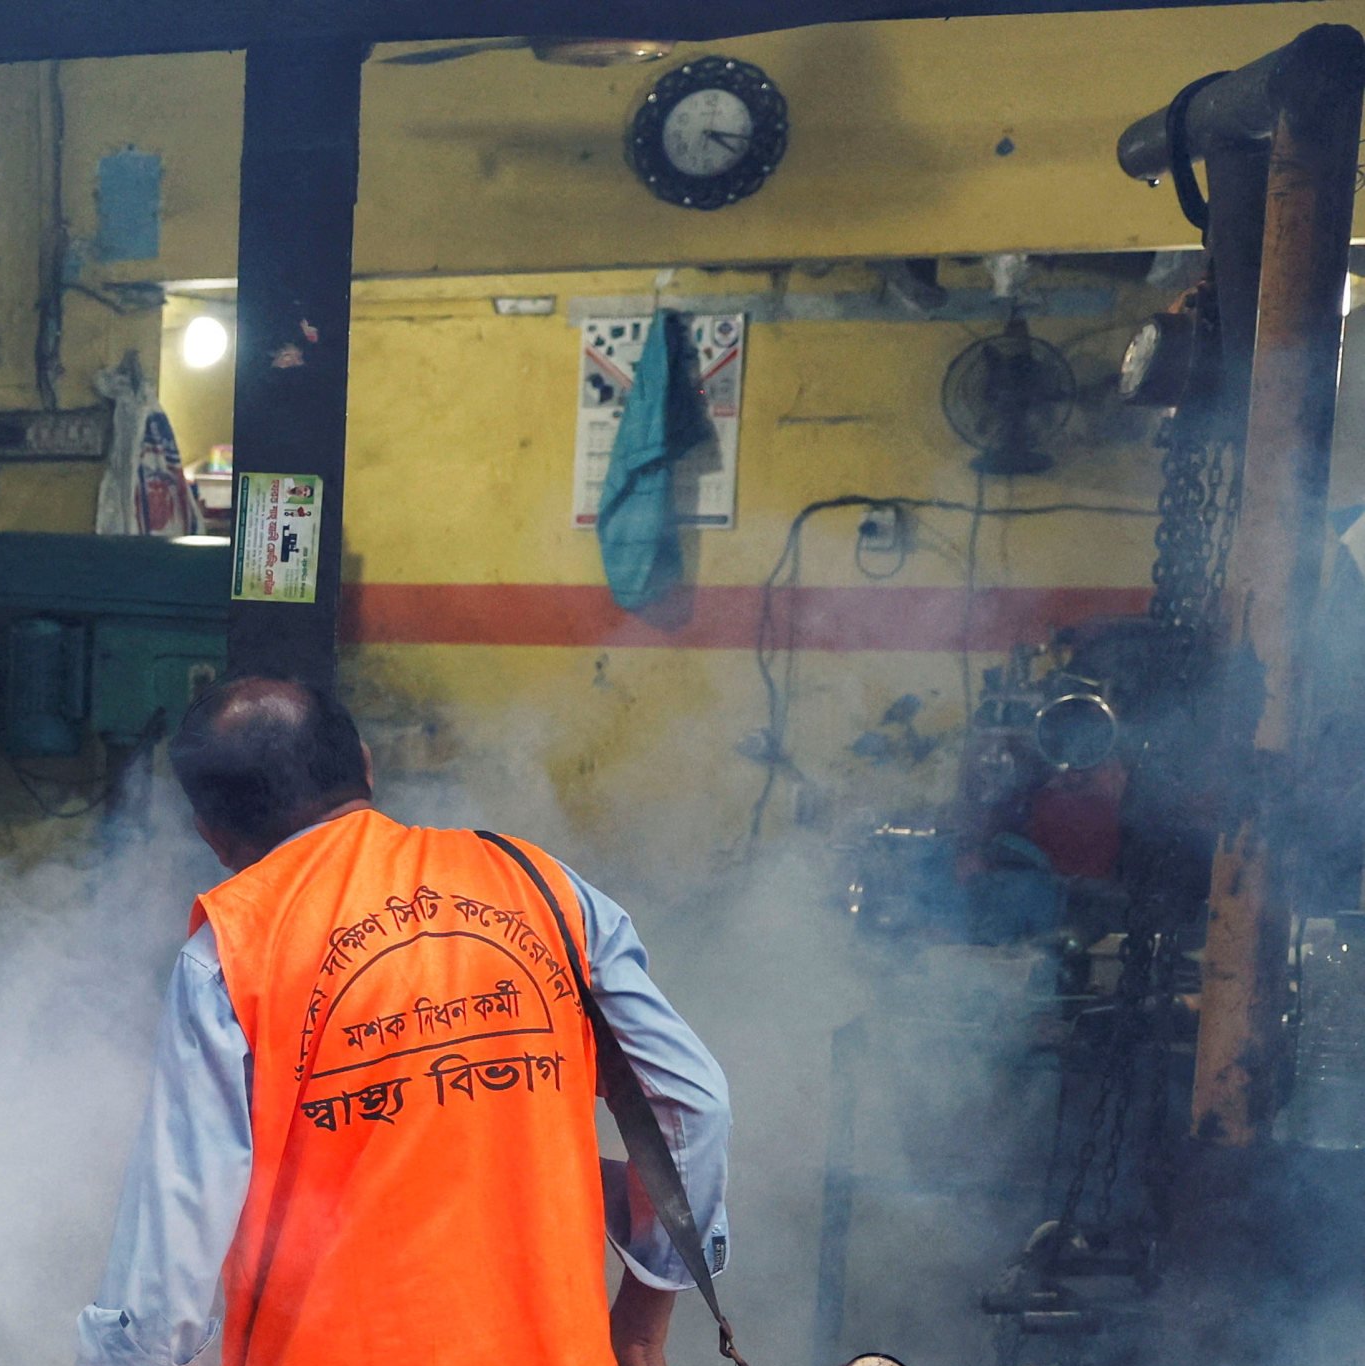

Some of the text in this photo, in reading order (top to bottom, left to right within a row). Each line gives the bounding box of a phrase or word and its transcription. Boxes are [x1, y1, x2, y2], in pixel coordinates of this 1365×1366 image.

[320, 913, 387, 976] দক্ষিণ
[385, 885, 444, 931] সিটি
[342, 1011, 407, 1051] মশক
[413, 996, 467, 1035] নিধন
[301, 1050, 567, 1132] স্বাস্থ্য বিভাগ
